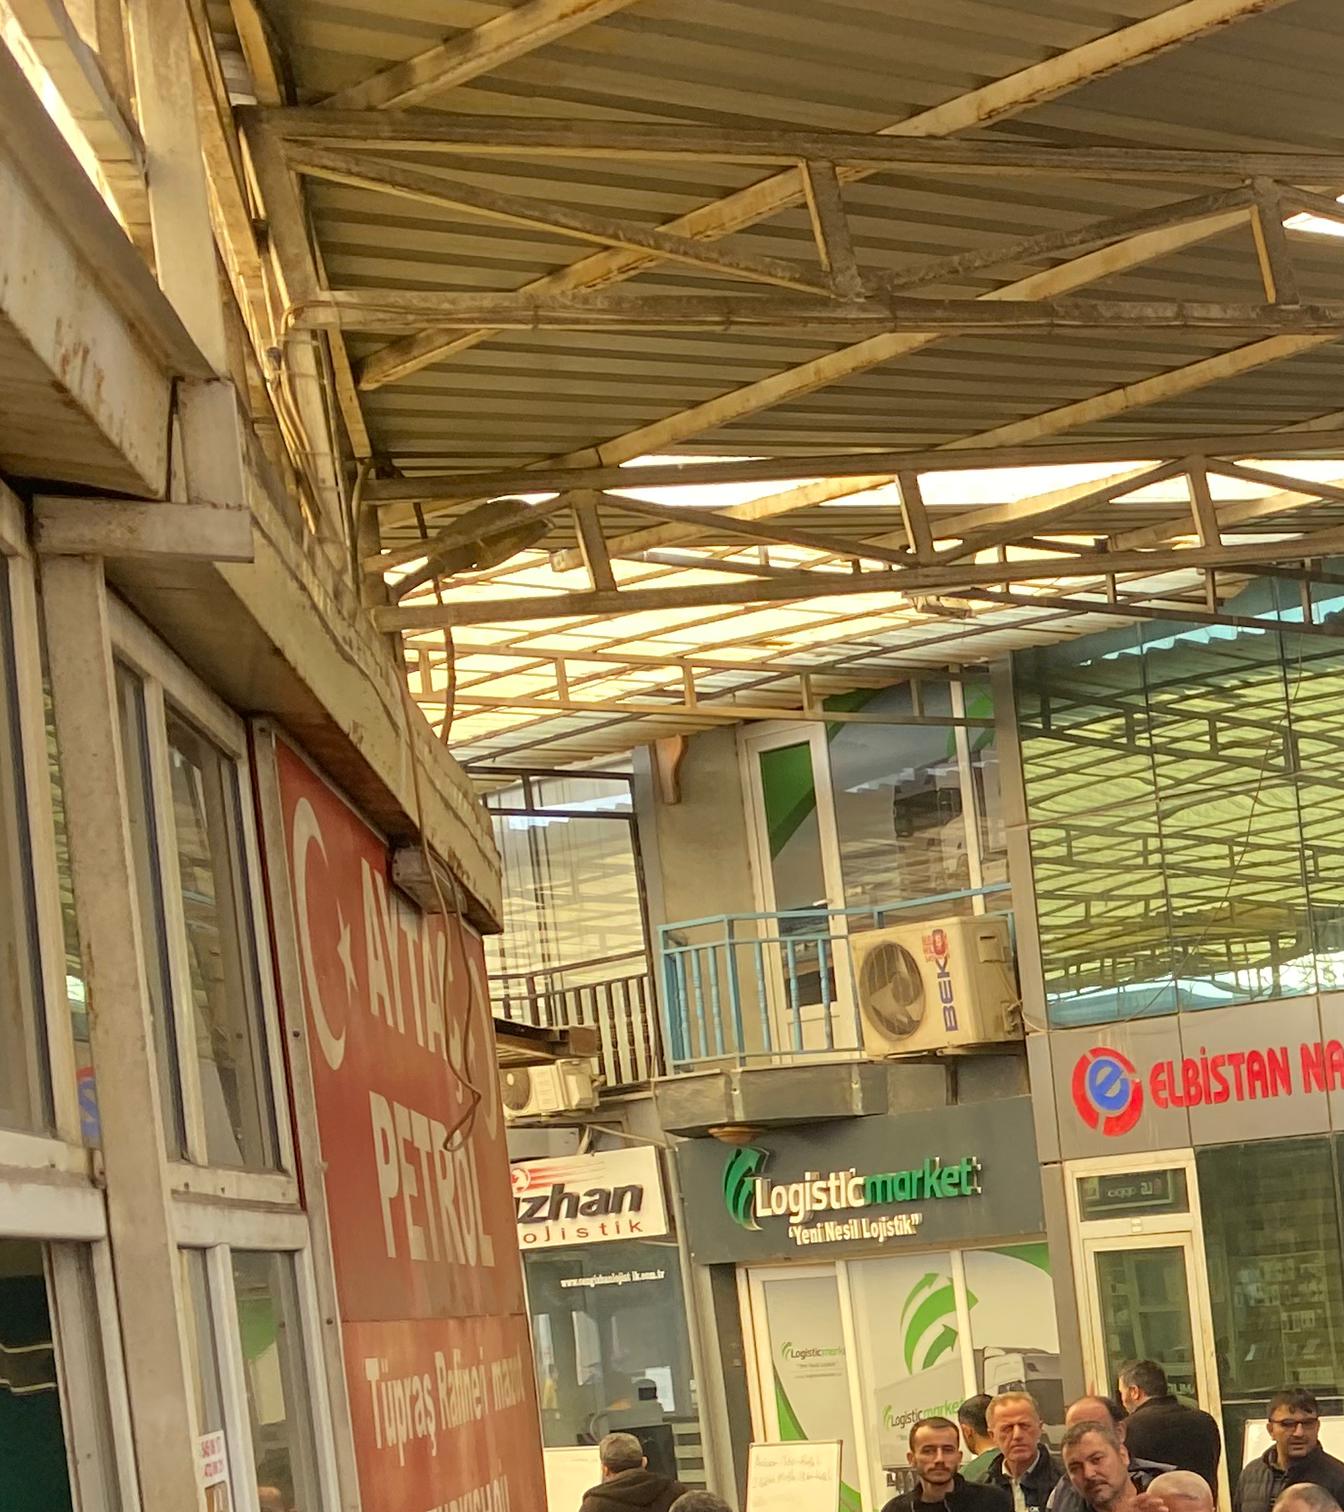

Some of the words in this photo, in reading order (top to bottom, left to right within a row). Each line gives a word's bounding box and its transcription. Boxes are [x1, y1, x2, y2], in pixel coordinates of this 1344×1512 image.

[1149, 1046, 1293, 1110] ELBİSTAN
[369, 1090, 496, 1268] PETROL
[755, 1157, 981, 1224] Logisticmarket
[824, 1217, 860, 1241] Nesil
